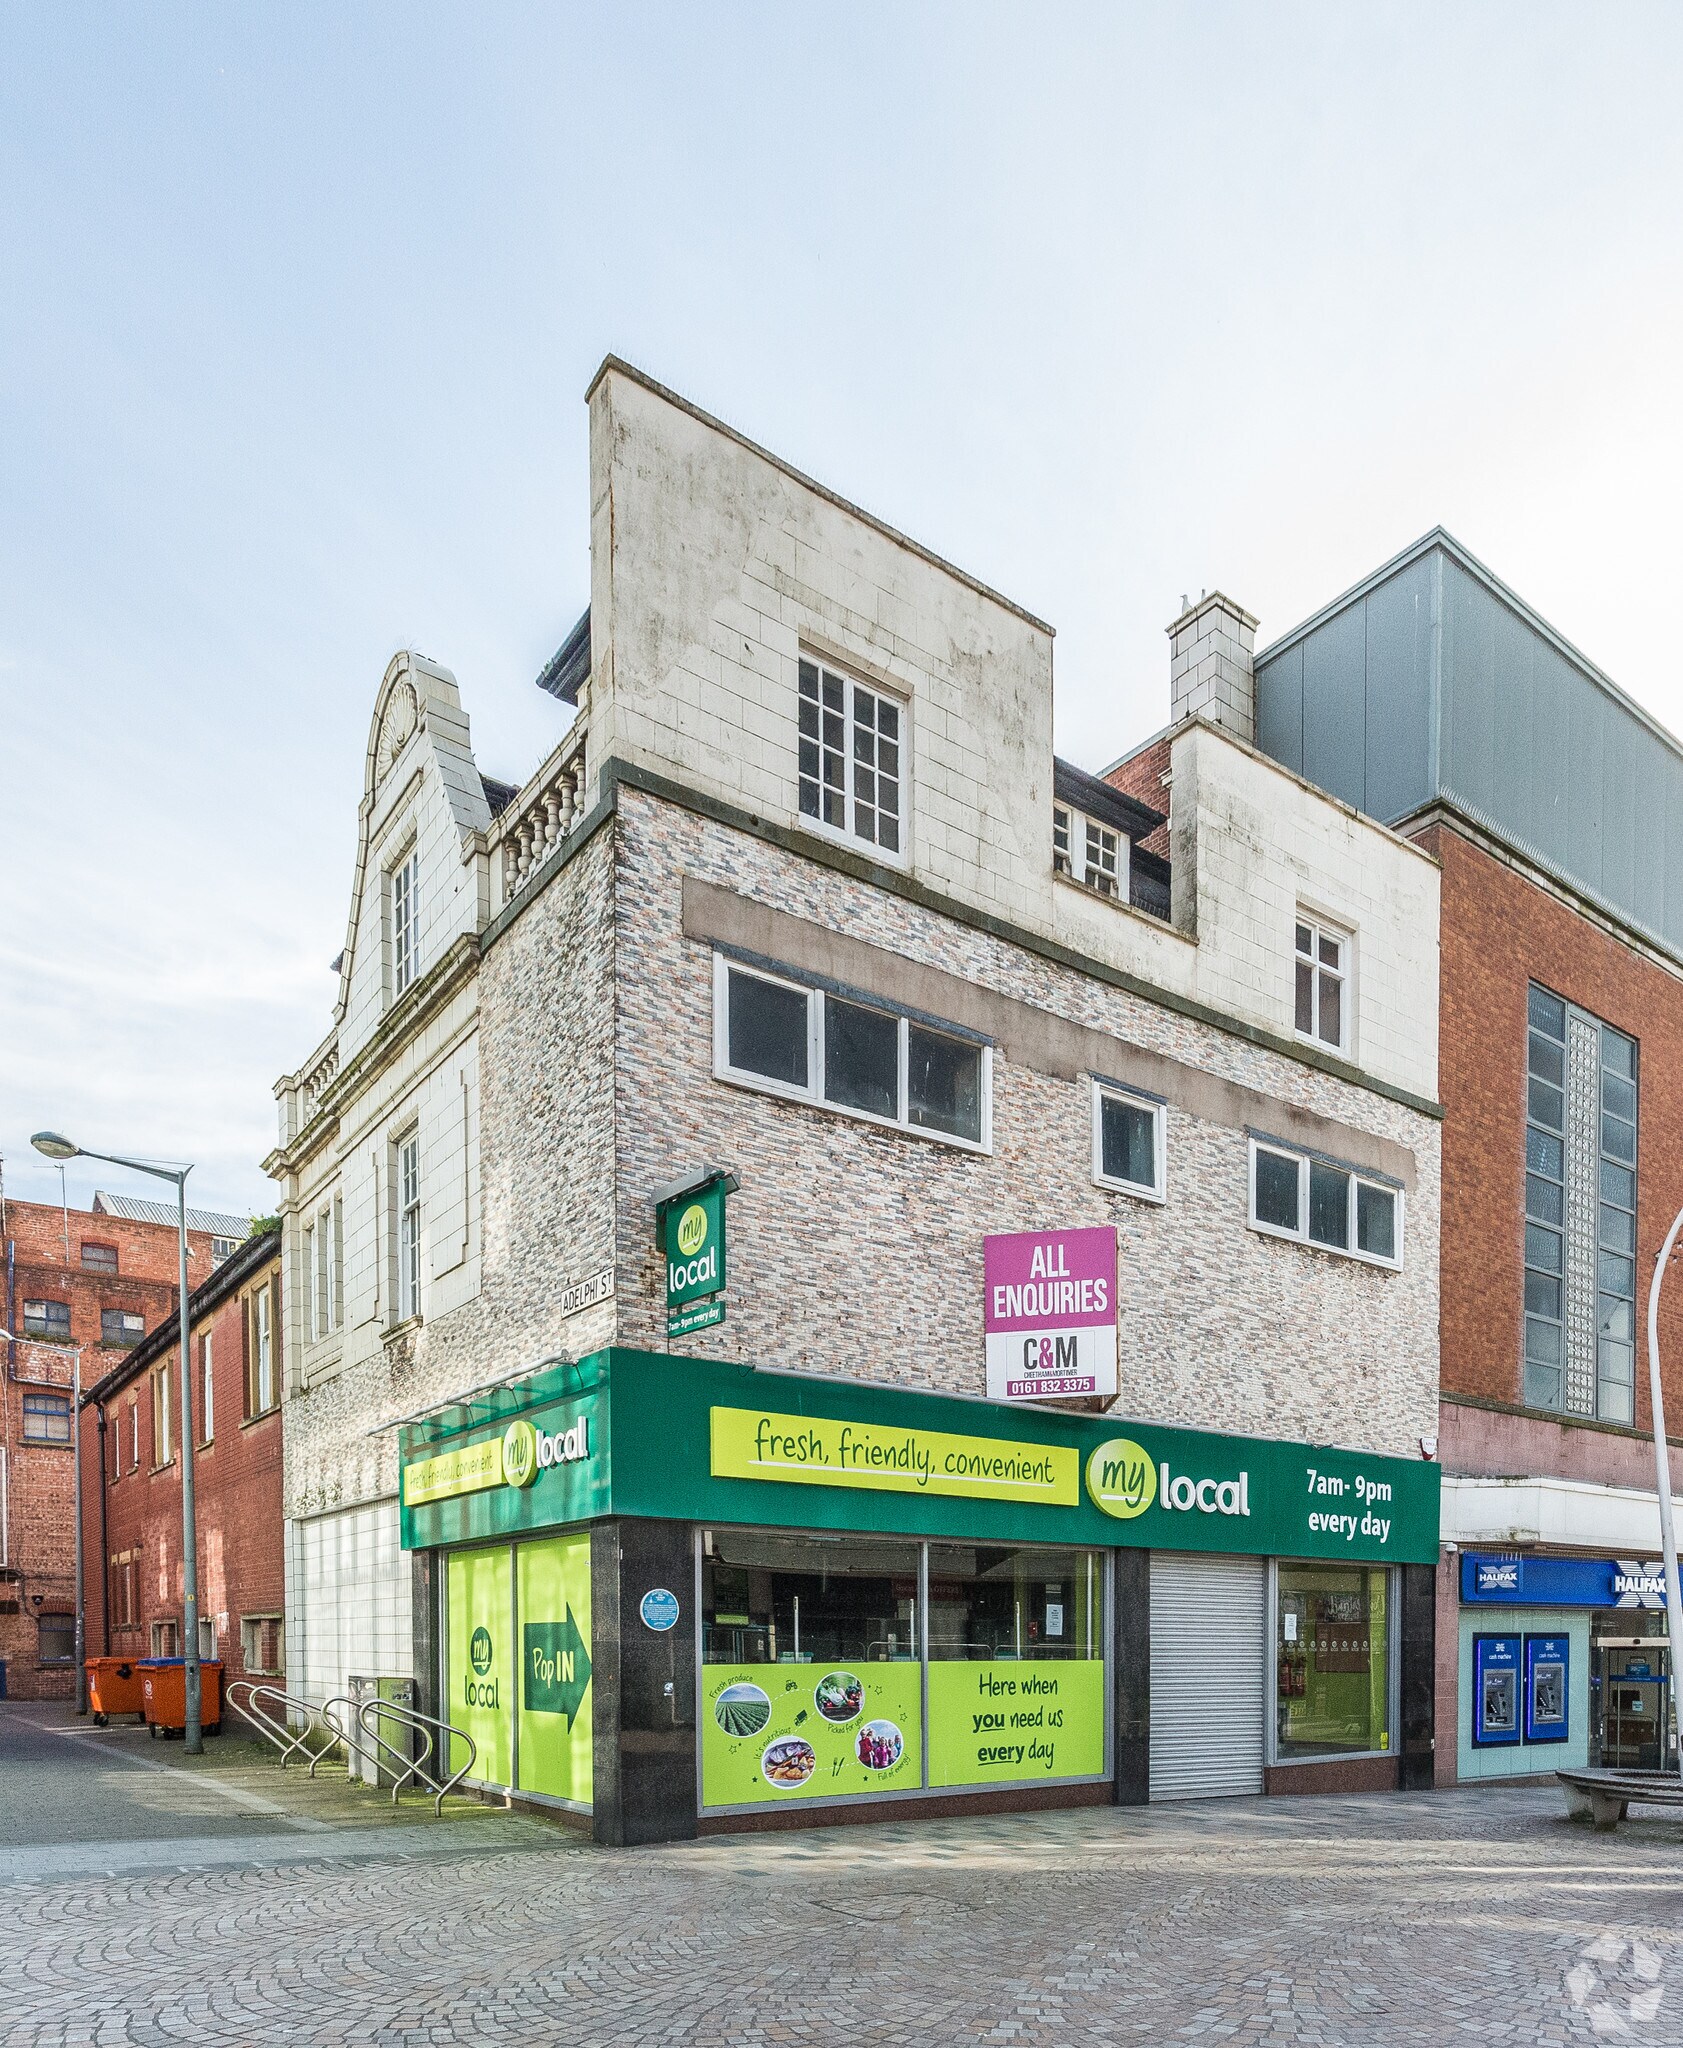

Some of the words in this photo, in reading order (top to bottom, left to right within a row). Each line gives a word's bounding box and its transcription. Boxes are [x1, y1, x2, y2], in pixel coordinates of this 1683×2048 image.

[682, 1214, 703, 1246] my
[669, 1246, 717, 1293] local
[1029, 1244, 1070, 1279] ALL
[562, 1279, 599, 1314] ADELPHI
[993, 1278, 1108, 1319] ENQUIRIES
[693, 1311, 709, 1323] every
[709, 1308, 720, 1319] day
[1023, 1335, 1078, 1370] C&M
[1012, 1381, 1037, 1394] 0161
[1040, 1380, 1061, 1392] 832
[1063, 1378, 1090, 1391] 3375
[507, 1436, 528, 1477] my
[536, 1416, 588, 1469] local
[754, 1418, 829, 1464] fresh,
[838, 1427, 936, 1486] friendly,
[944, 1452, 1055, 1483] convenient
[456, 1450, 494, 1478] convenient
[1101, 1459, 1146, 1509] my
[1159, 1462, 1251, 1517] local
[1354, 1475, 1392, 1506] 9pm
[1308, 1511, 1358, 1541] every
[1360, 1510, 1391, 1544] day
[1479, 1572, 1518, 1582] HALIFAX
[1614, 1574, 1667, 1593] HALIFAX
[473, 1637, 490, 1671] my
[556, 1650, 575, 1683] IN
[464, 1675, 500, 1710] local
[708, 1681, 727, 1699] Fresh
[727, 1673, 754, 1685] produce
[979, 1672, 1017, 1697] Here
[1021, 1674, 1058, 1695] when
[827, 1723, 845, 1734] Picked
[845, 1722, 854, 1734] for
[854, 1716, 864, 1730] you
[972, 1713, 1005, 1733] you
[1010, 1705, 1044, 1728] need
[1048, 1709, 1064, 1728] us
[763, 1727, 792, 1748] nutritious
[977, 1745, 1025, 1765] every
[1028, 1737, 1055, 1770] day
